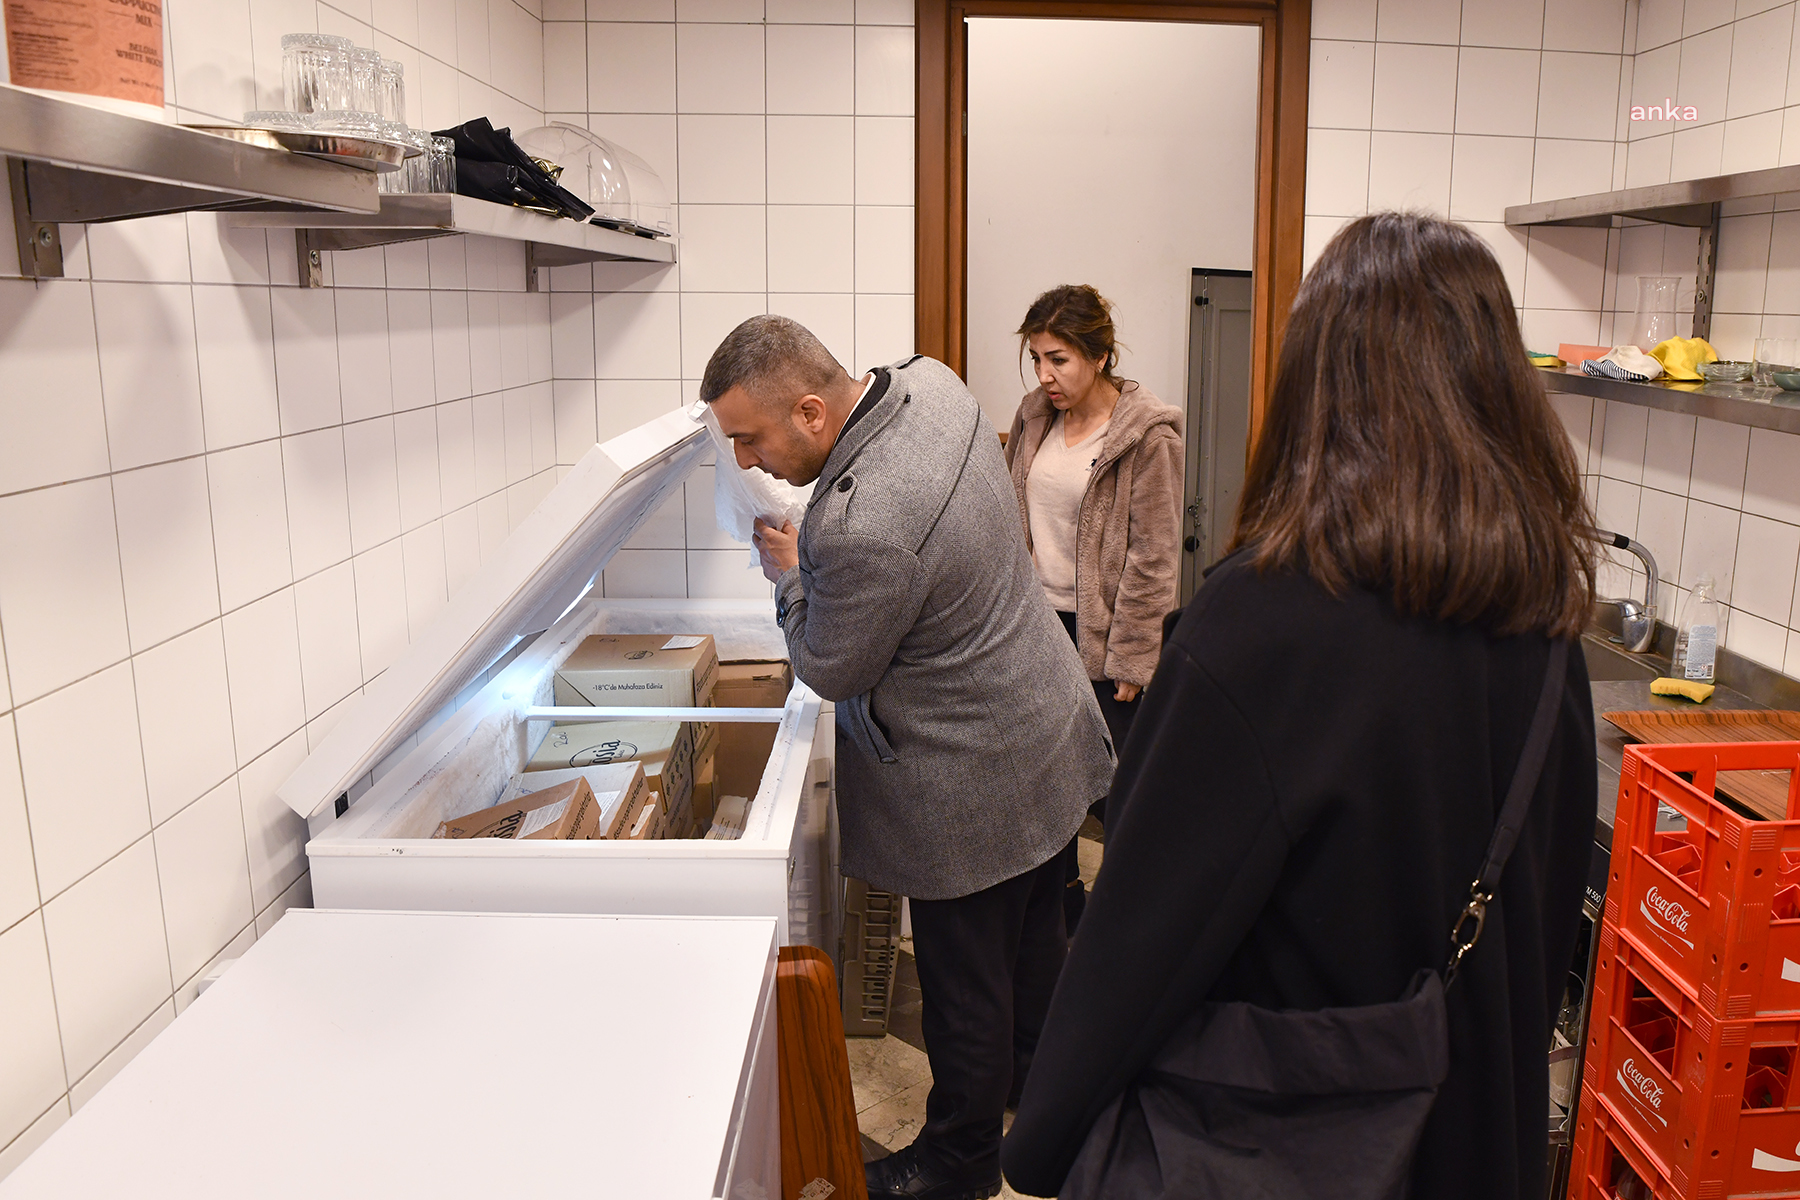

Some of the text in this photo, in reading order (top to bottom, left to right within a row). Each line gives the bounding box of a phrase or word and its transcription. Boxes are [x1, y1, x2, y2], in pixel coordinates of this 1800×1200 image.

[135, 13, 153, 28] MIX
[116, 49, 143, 62] WHITE
[617, 683, 646, 691] Muhafaza
[1591, 890, 1602, 903] 500
